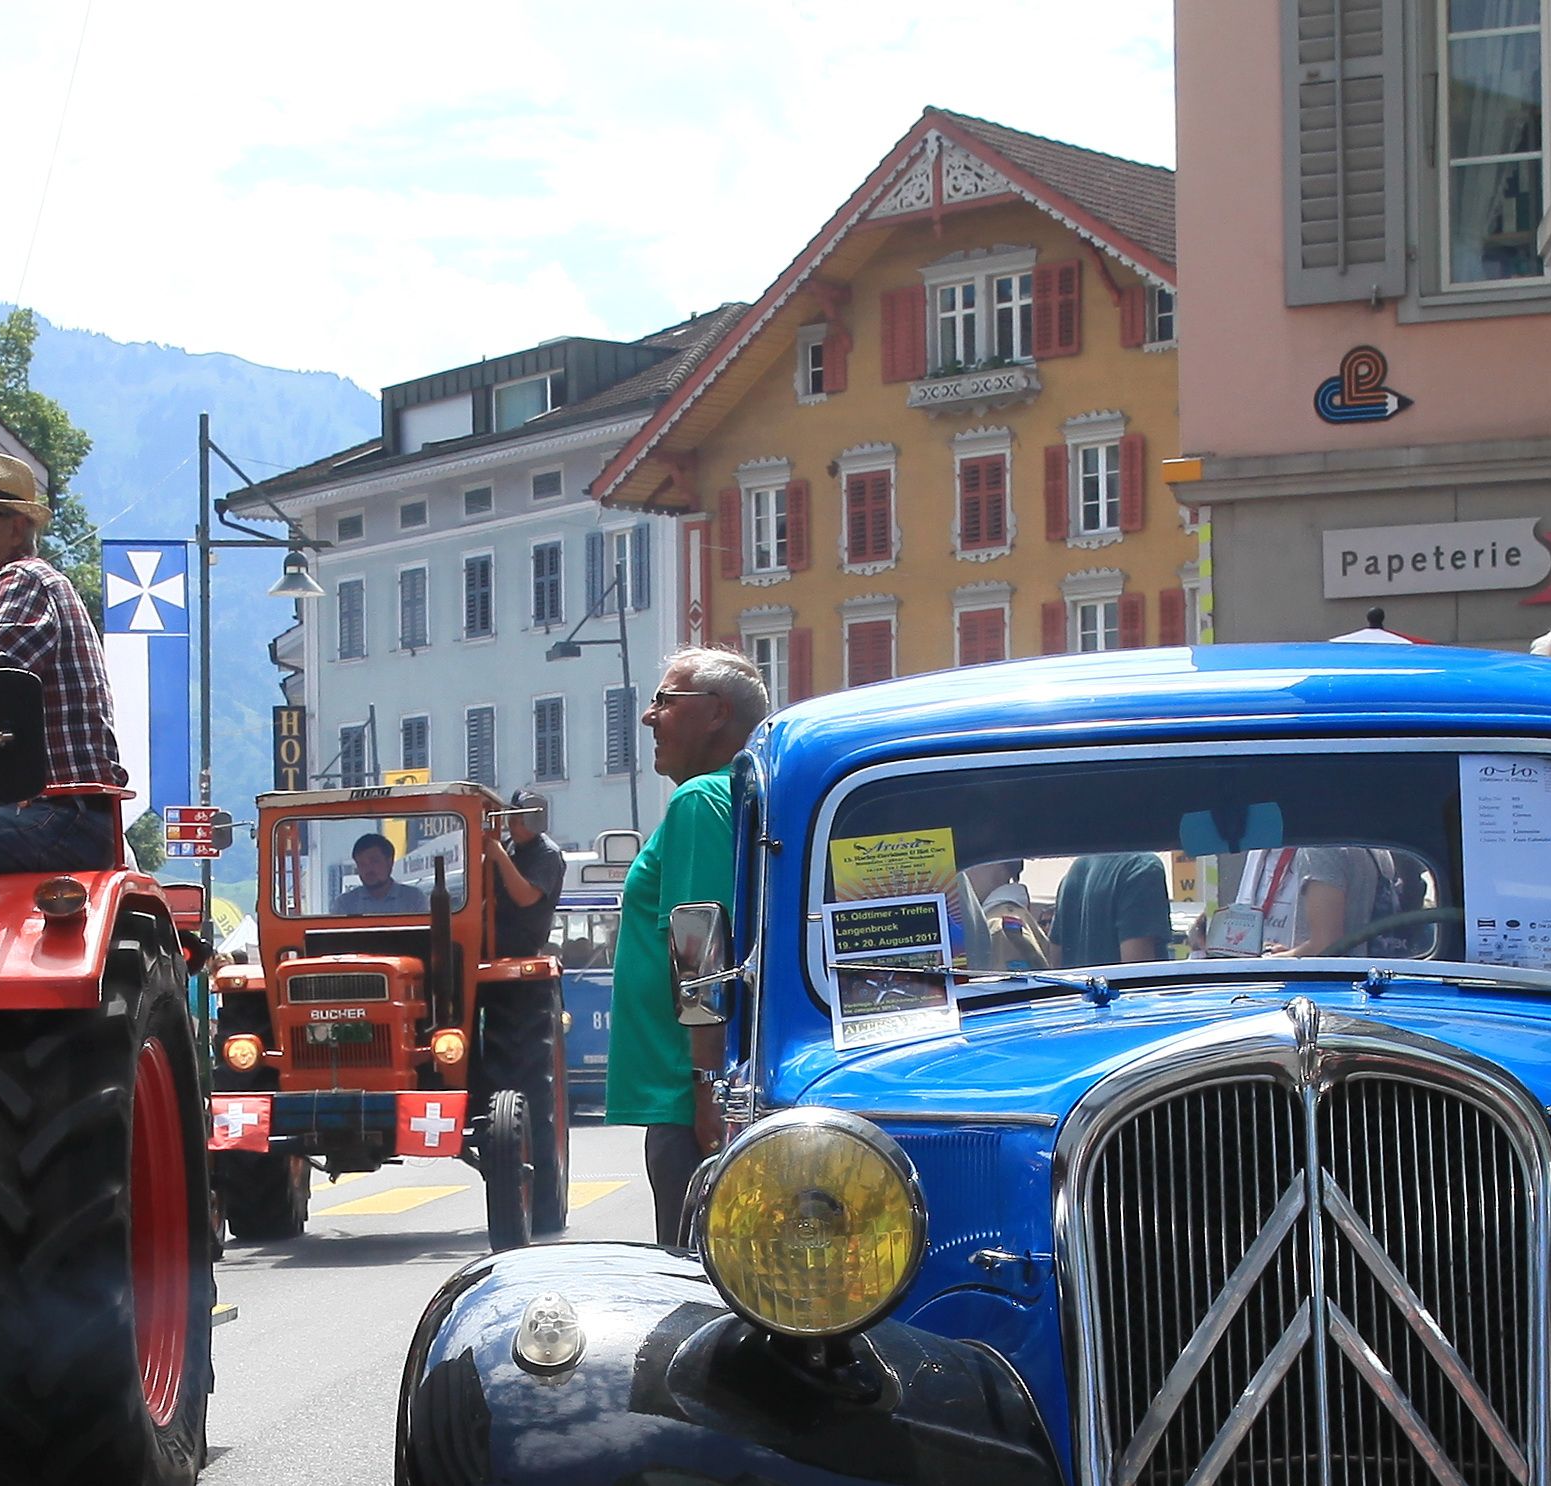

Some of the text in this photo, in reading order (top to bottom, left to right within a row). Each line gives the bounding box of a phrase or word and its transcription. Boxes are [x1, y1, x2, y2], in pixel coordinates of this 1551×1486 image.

[1341, 542, 1521, 581] Papeterie
[851, 910, 892, 921] Oldtimer
[900, 905, 935, 916] Treffen
[836, 923, 899, 936] Langenbruck
[879, 936, 914, 946] August
[916, 932, 938, 942] 2017
[311, 1008, 366, 1020] BUCHER
